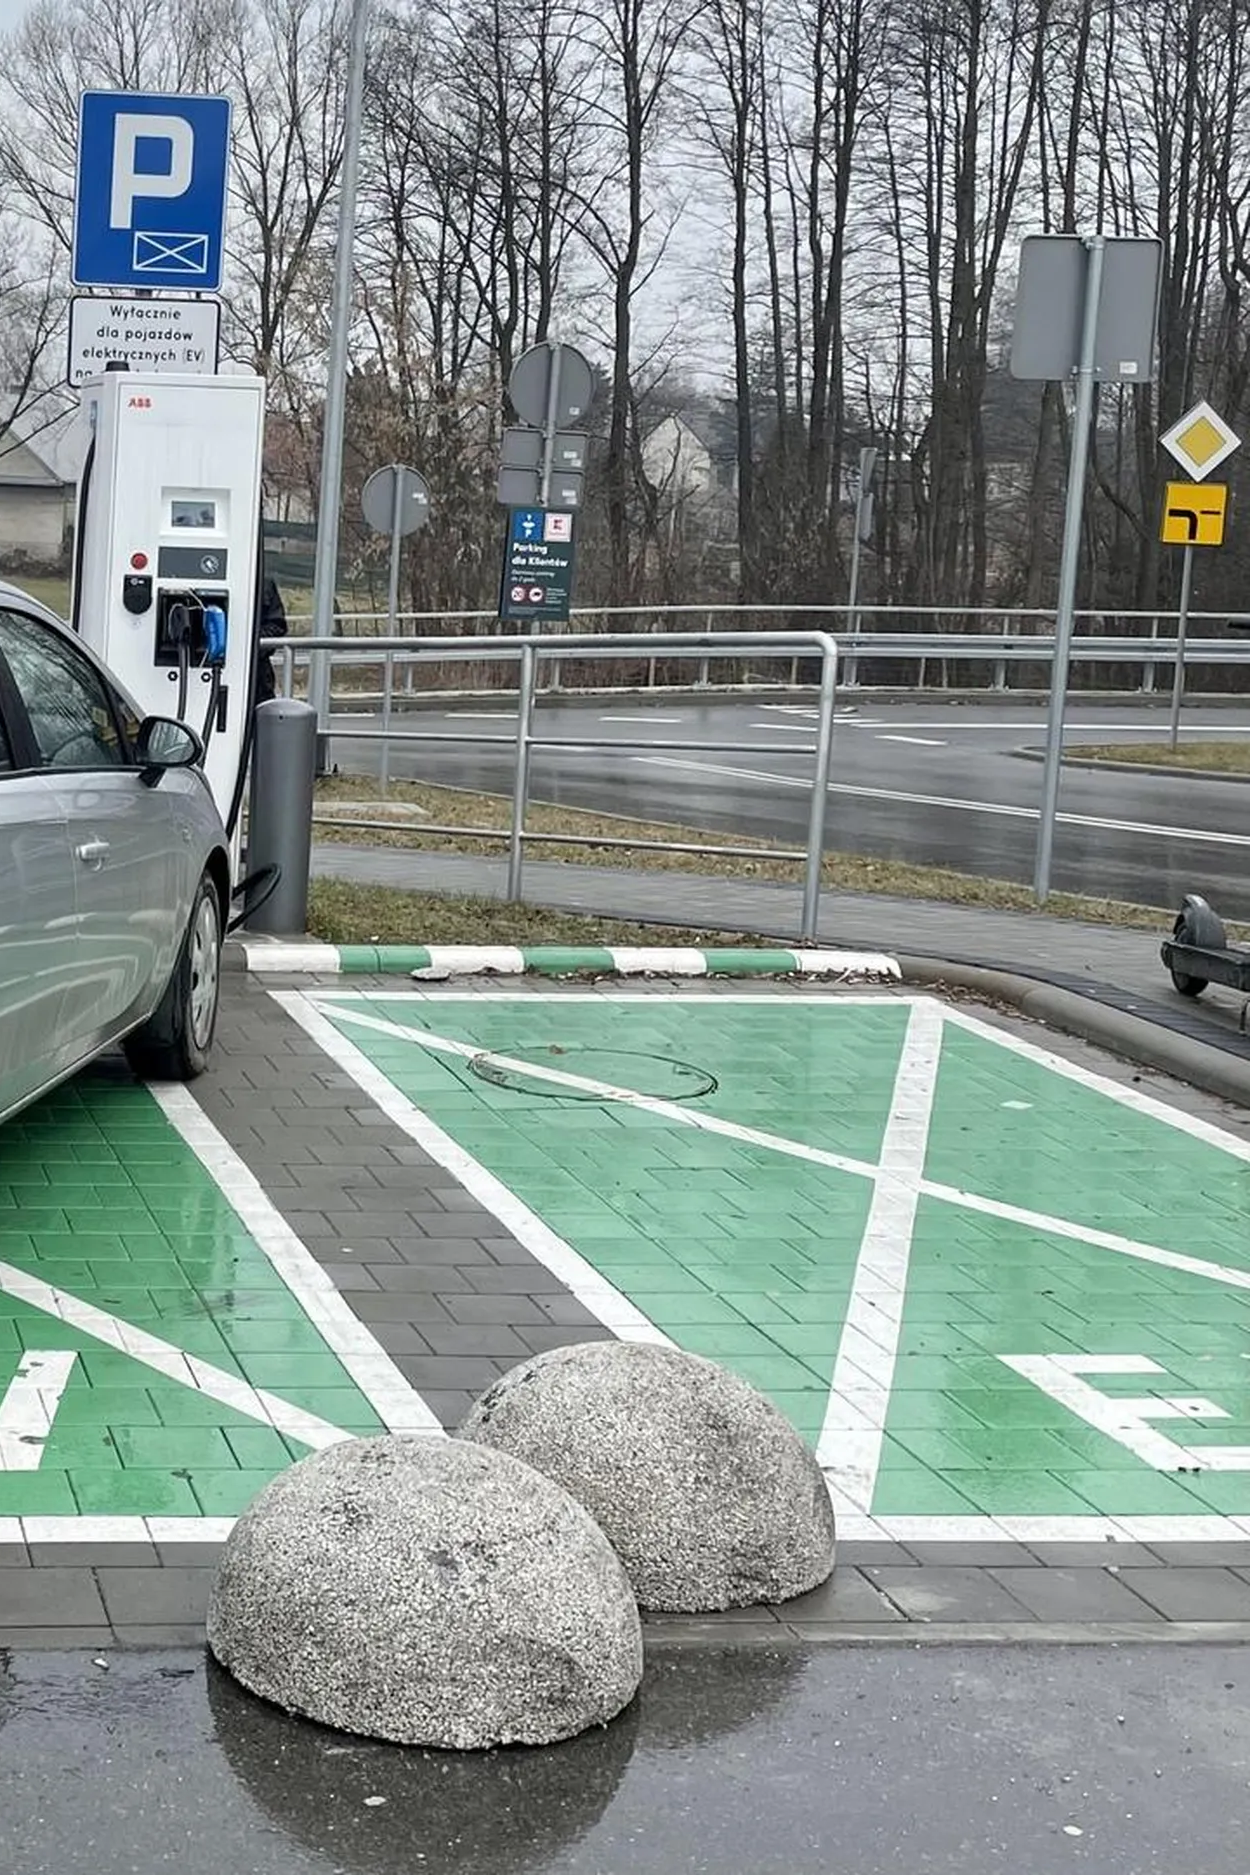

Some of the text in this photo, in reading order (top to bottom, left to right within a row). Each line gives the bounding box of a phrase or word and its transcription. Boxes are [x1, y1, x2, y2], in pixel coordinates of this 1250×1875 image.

[110, 112, 195, 229] P
[110, 305, 181, 321] Wyłącznie
[96, 327, 193, 343] dla pojazdów
[82, 347, 176, 364] elektrycznych
[128, 398, 151, 408] ABB
[513, 543, 548, 555] Parking
